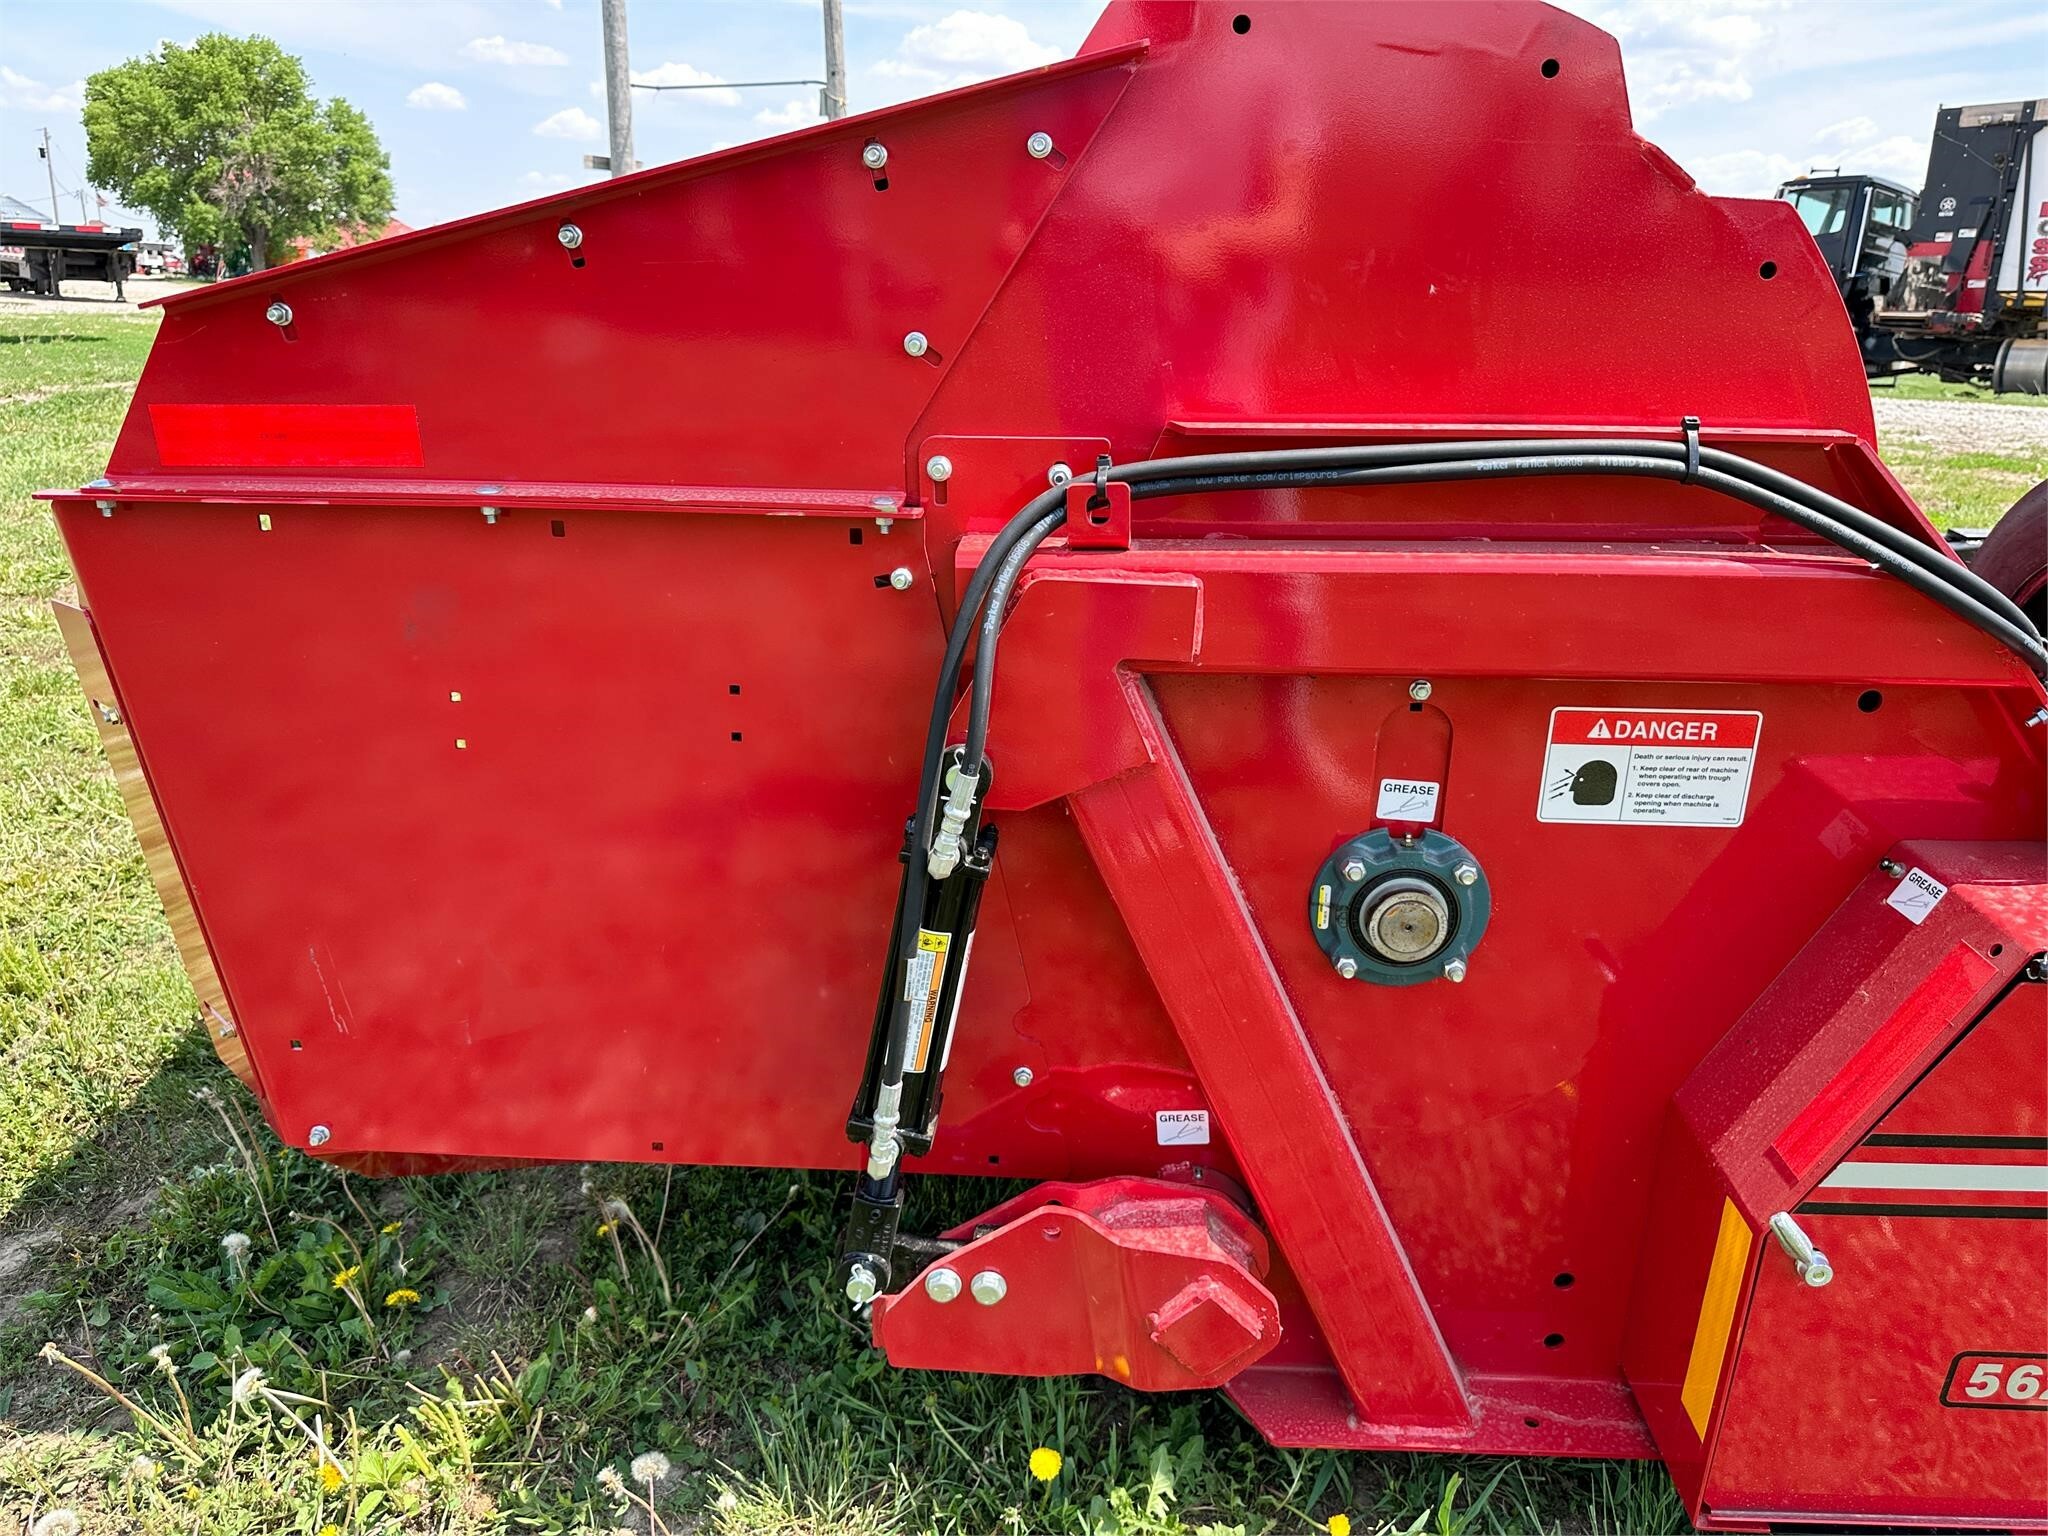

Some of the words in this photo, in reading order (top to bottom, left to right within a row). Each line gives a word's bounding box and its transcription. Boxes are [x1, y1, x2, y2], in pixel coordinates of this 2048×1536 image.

[983, 599, 1000, 634] Parker
[1614, 720, 1718, 741] DANGER
[1691, 754, 1711, 762] injury
[1383, 783, 1435, 796] GREASE
[1634, 800, 1662, 808] opening
[1908, 872, 1943, 899] GREASE
[924, 989, 938, 1023] WARNING
[1159, 1113, 1205, 1123] GREASE
